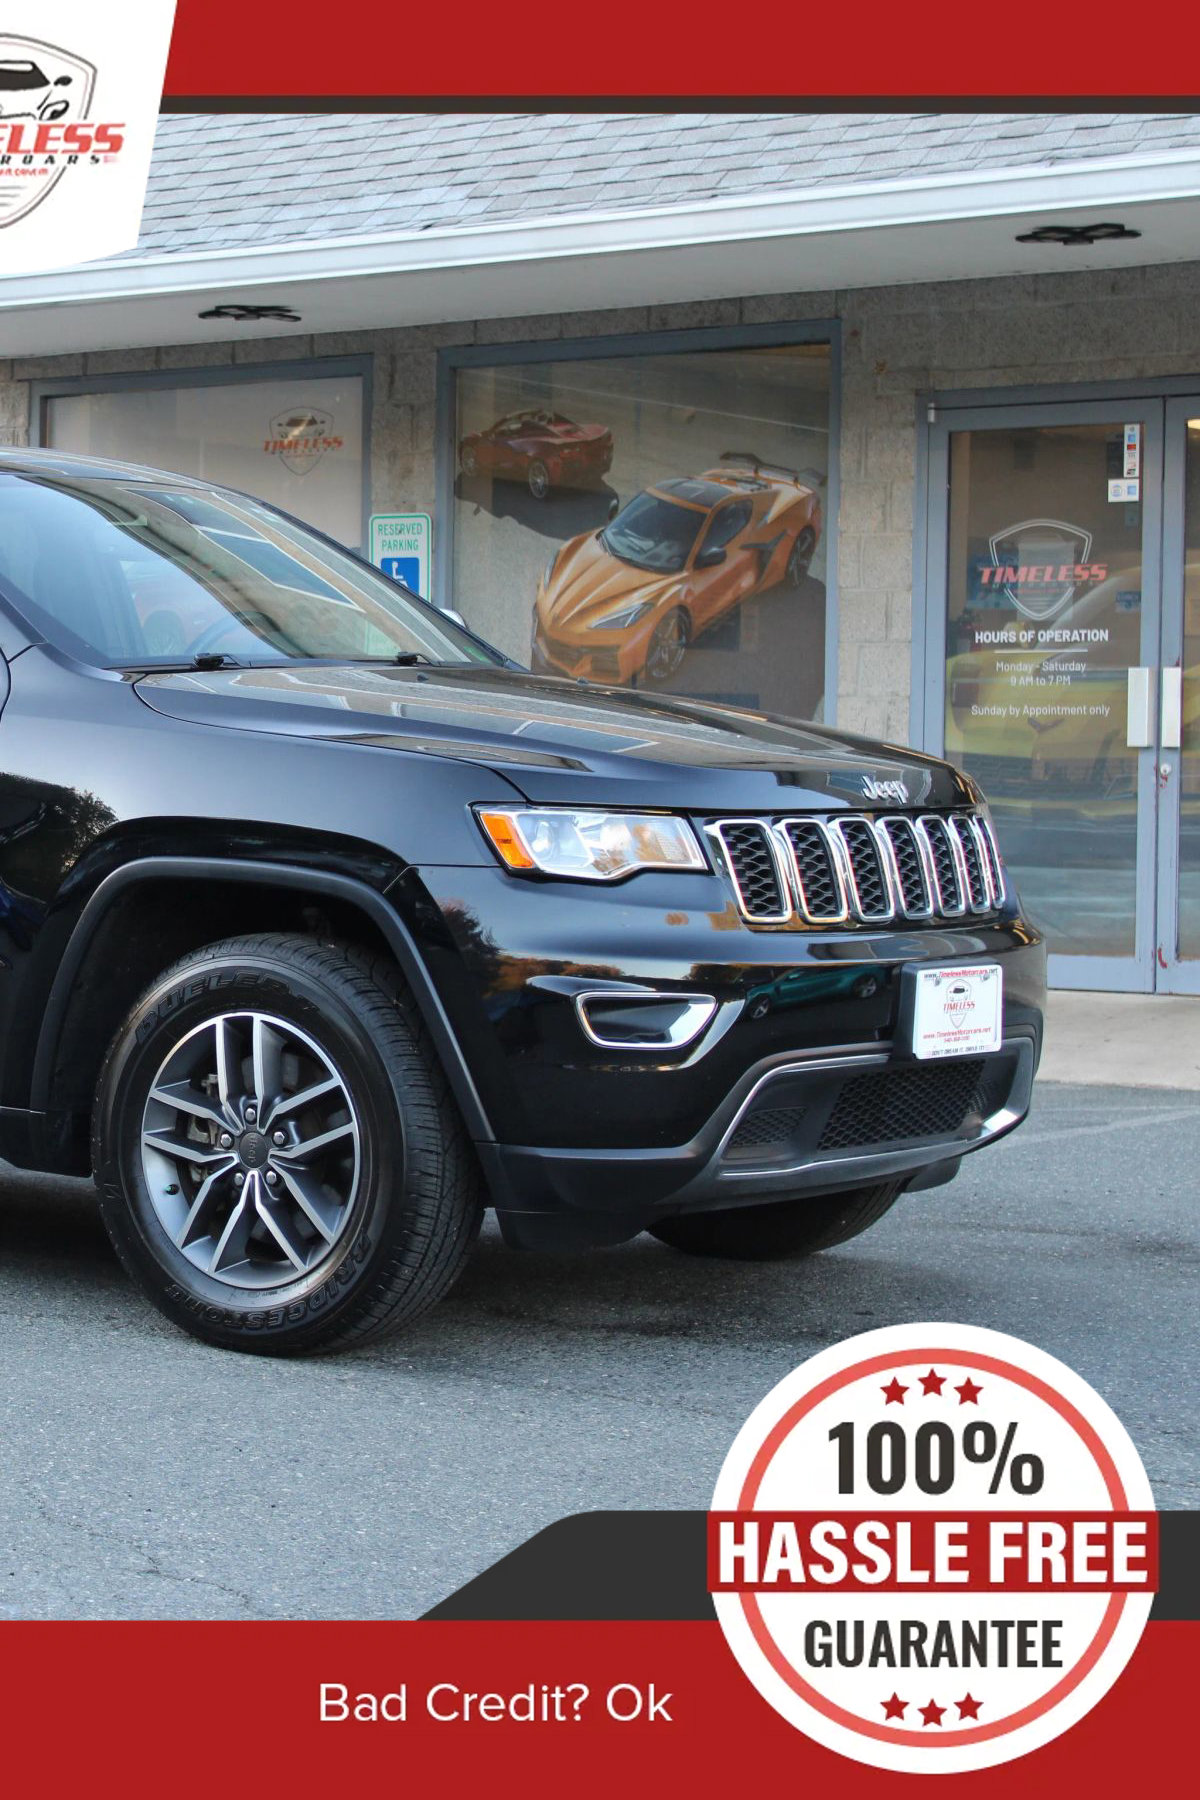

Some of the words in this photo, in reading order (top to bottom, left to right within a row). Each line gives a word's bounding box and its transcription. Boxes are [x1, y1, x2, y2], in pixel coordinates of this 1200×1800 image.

[377, 523, 422, 535] RESERVED
[382, 539, 419, 550] PARKING
[978, 564, 1108, 584] TIMELESS
[975, 630, 1016, 643] HOURS
[1019, 630, 1035, 642] OF
[1038, 629, 1109, 642] OPERATION
[996, 662, 1036, 675] Monday
[1042, 661, 1086, 675] Saturday
[1010, 677, 1017, 686] 9
[1019, 676, 1034, 685] AM
[1036, 677, 1046, 685] to
[1049, 676, 1054, 686] 7
[1055, 676, 1071, 685] PM
[971, 705, 1007, 718] Sunday
[1009, 704, 1020, 717] by
[1022, 704, 1087, 717] Appointment
[1089, 703, 1110, 716] only
[861, 775, 909, 805] Jeep
[135, 970, 290, 1045] DUELER
[944, 1001, 975, 1011] TIMELESS
[162, 1231, 373, 1332] BRIDGESTONE
